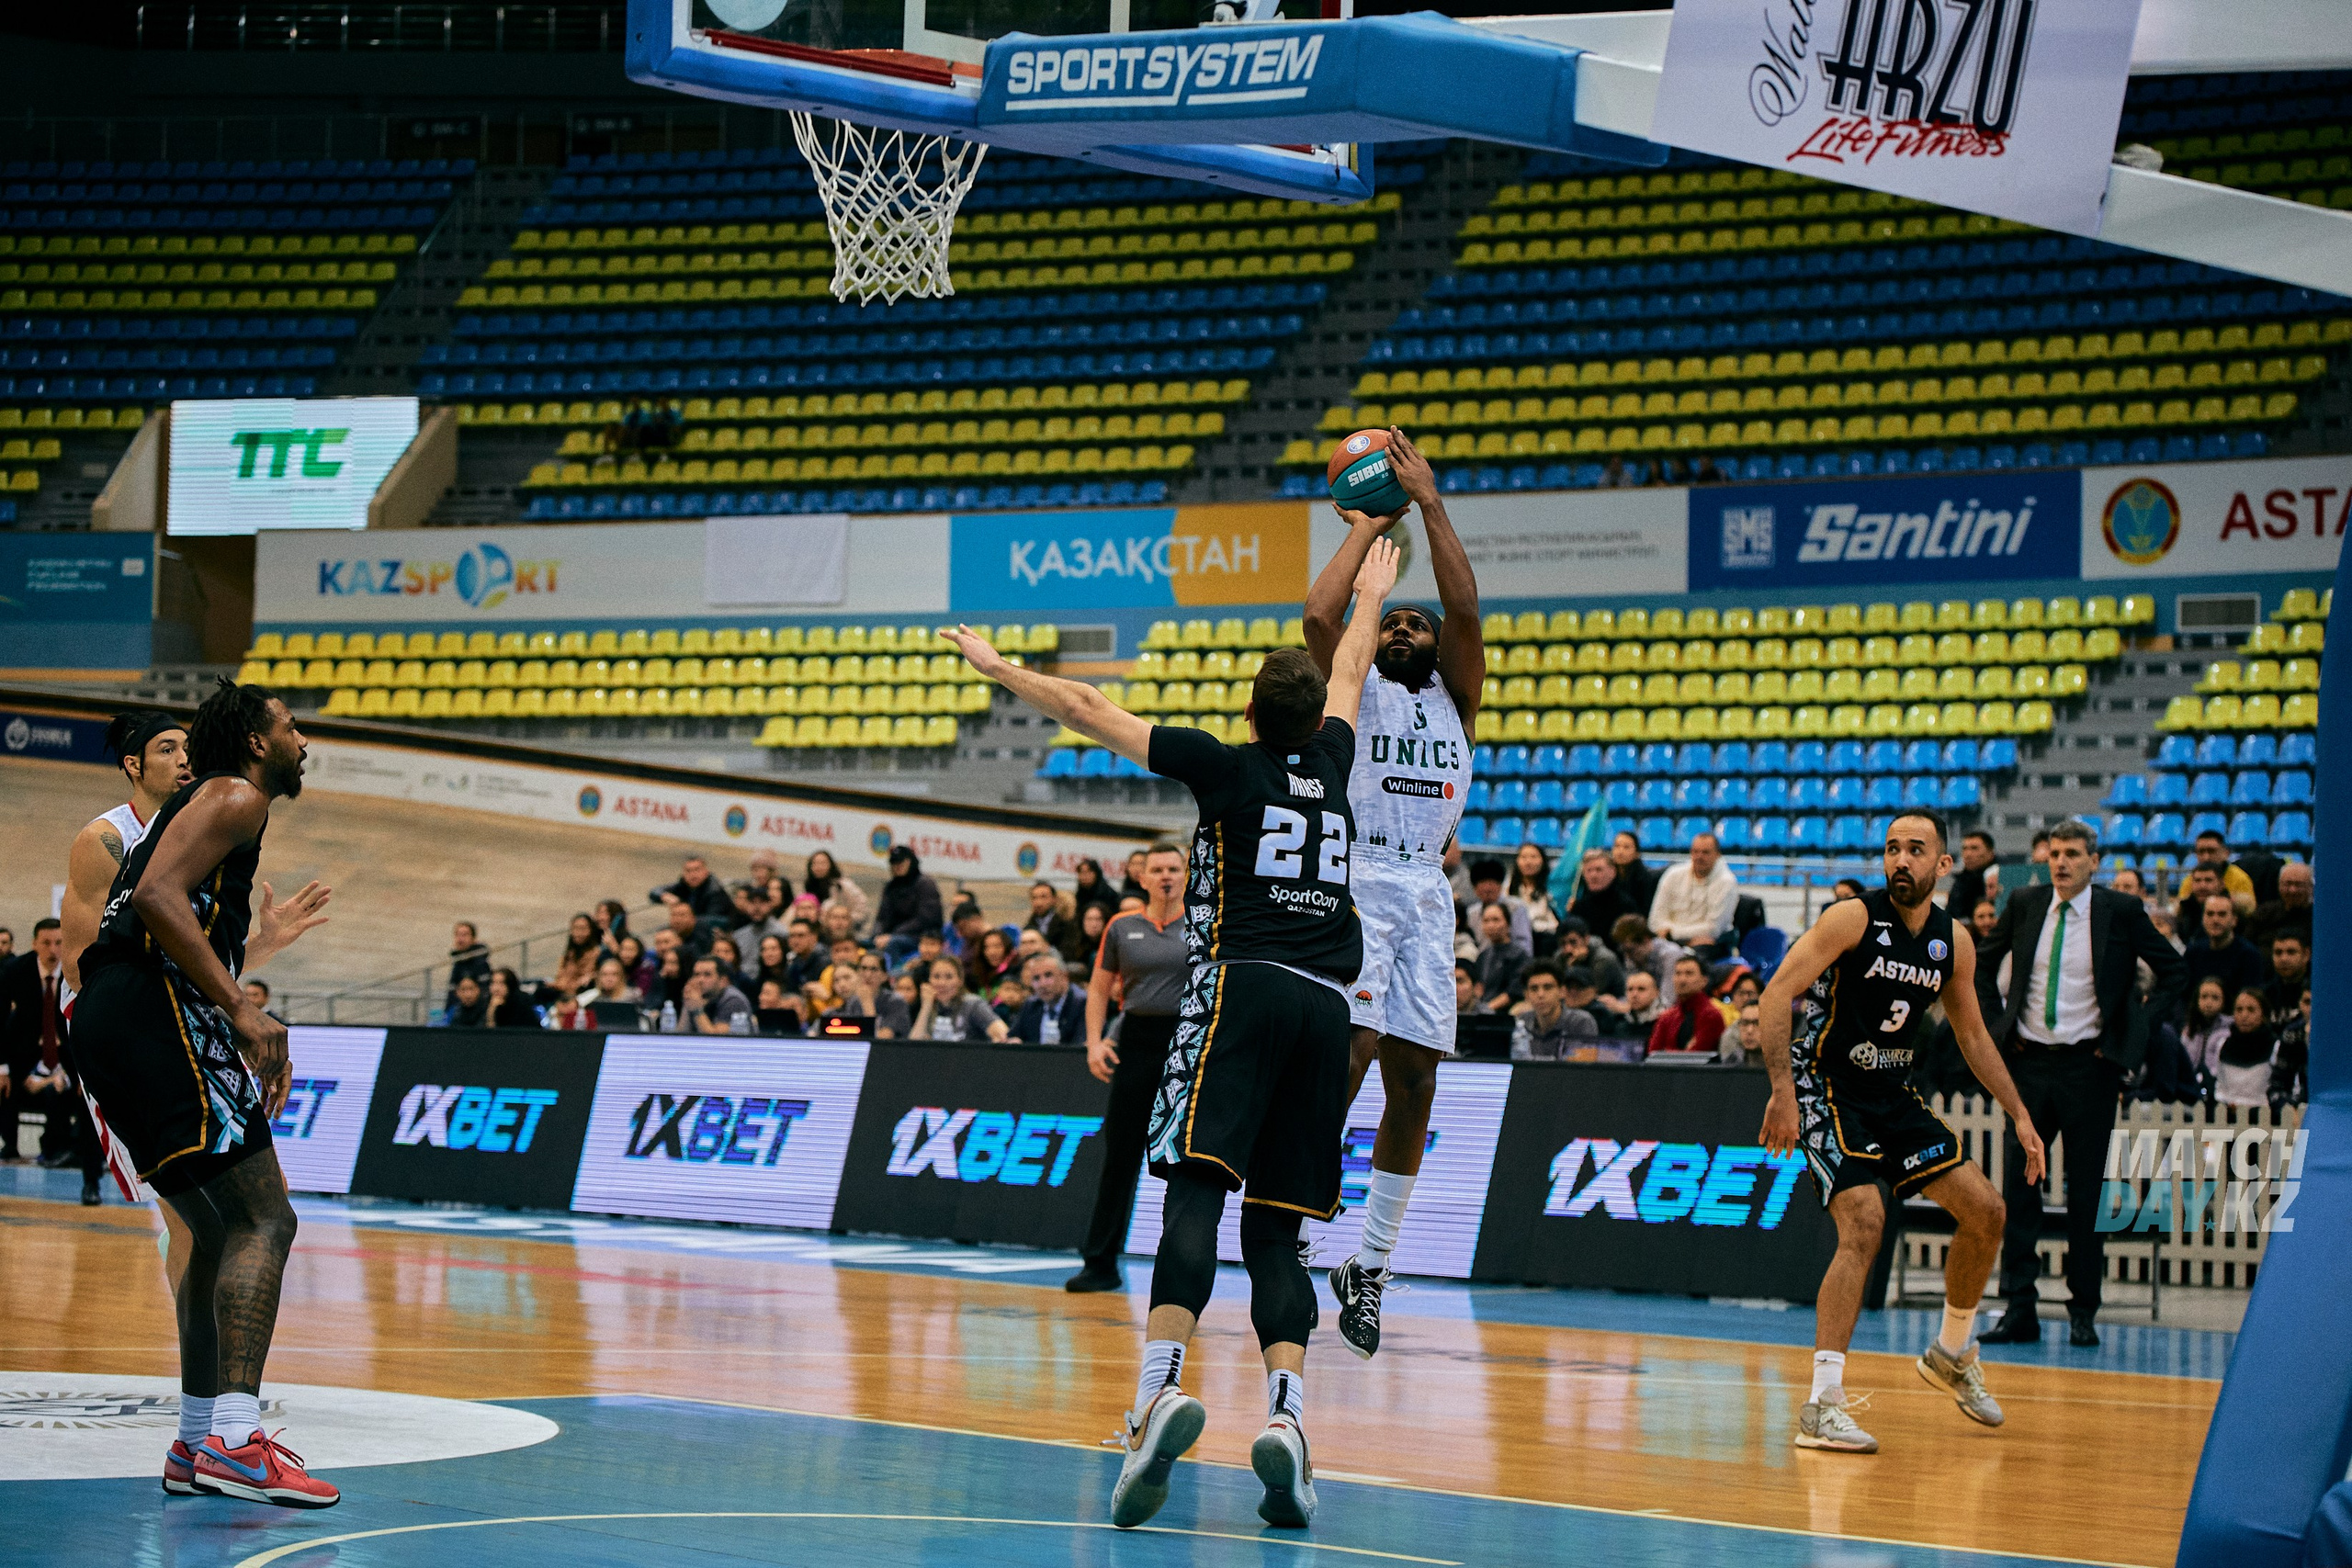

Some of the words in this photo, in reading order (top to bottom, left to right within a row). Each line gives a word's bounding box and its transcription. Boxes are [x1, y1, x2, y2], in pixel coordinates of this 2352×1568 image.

[1797, 496, 2038, 563] Santini
[1010, 534, 1261, 587] ҚАЗАҚСТАН
[1372, 735, 1460, 771] UNICS
[1387, 779, 1440, 796] Winline
[614, 795, 689, 823] ASTANA
[759, 815, 835, 841] ASTANA
[1254, 805, 1348, 886] 22
[1269, 885, 1340, 912] SportQory
[1864, 955, 1942, 993] ASTANA
[1880, 999, 1910, 1032] 3
[392, 1084, 559, 1153] 1XBET
[625, 1093, 813, 1168] 1XBET
[886, 1106, 1105, 1188] 1XBET
[1904, 1143, 1946, 1170] 1XBET
[1543, 1137, 1808, 1230] 1XBET
